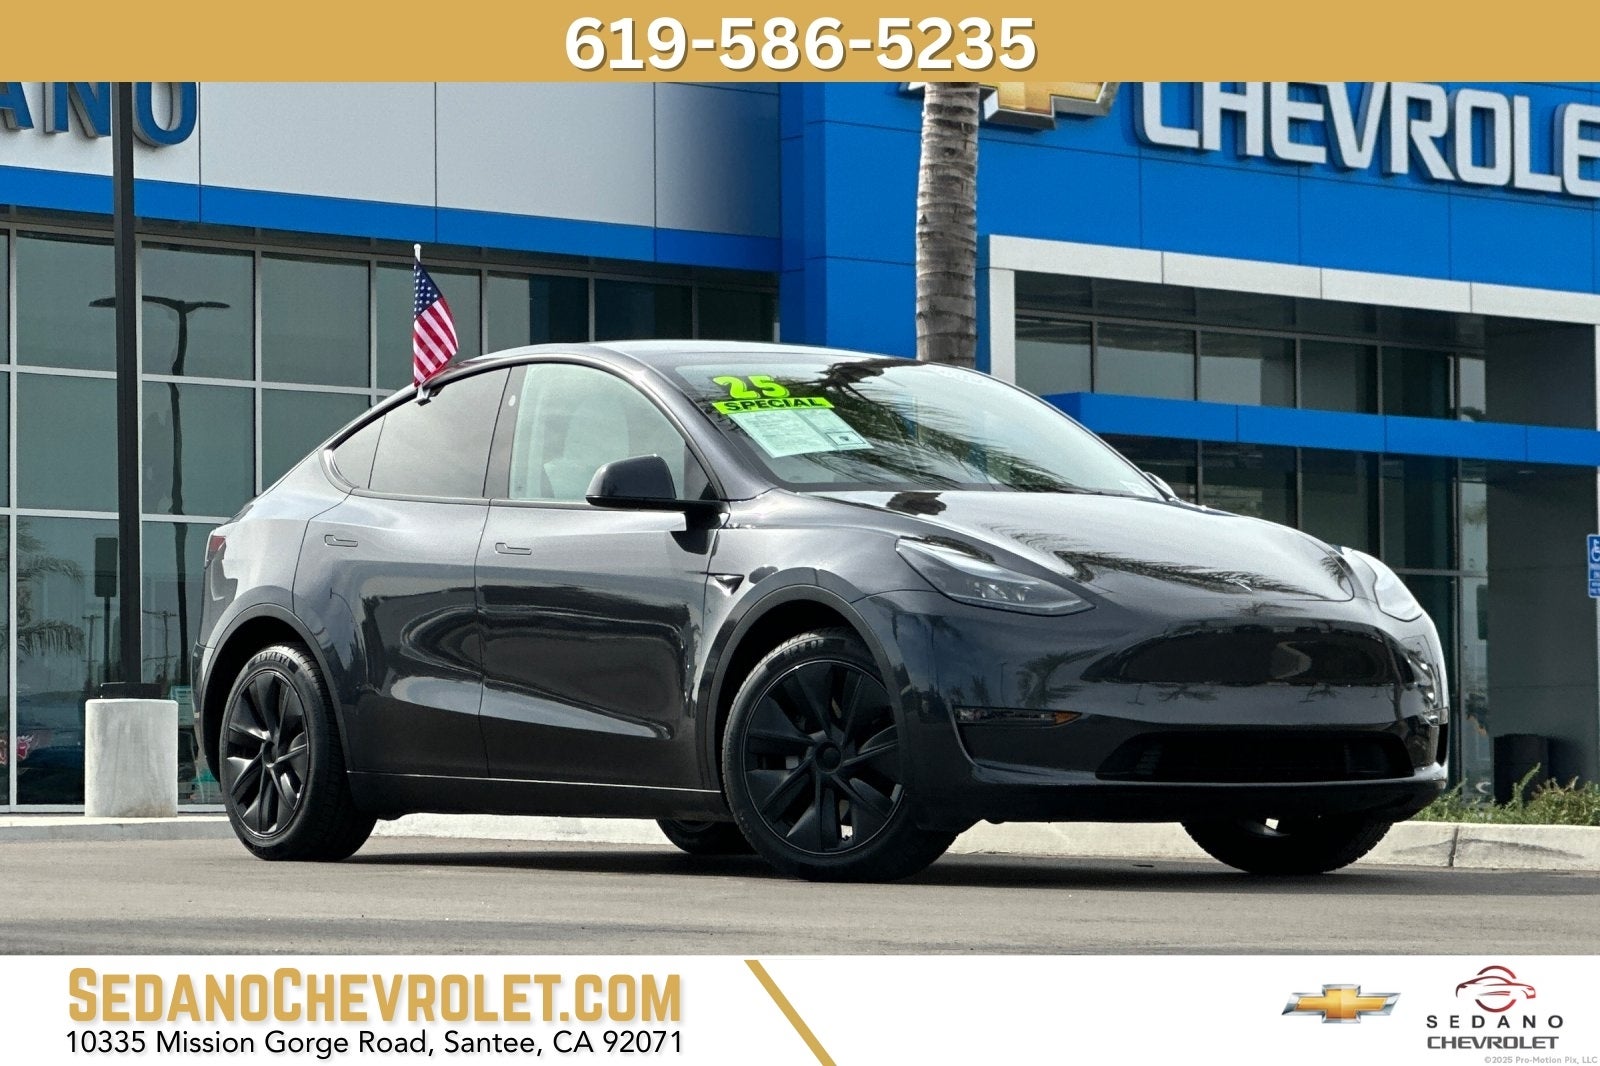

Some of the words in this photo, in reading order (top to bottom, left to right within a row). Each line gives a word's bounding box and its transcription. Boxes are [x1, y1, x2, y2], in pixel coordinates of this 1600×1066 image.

[1143, 81, 1600, 198] CHEVROLE
[712, 375, 790, 399] 25
[725, 399, 823, 411] SPECIAL
